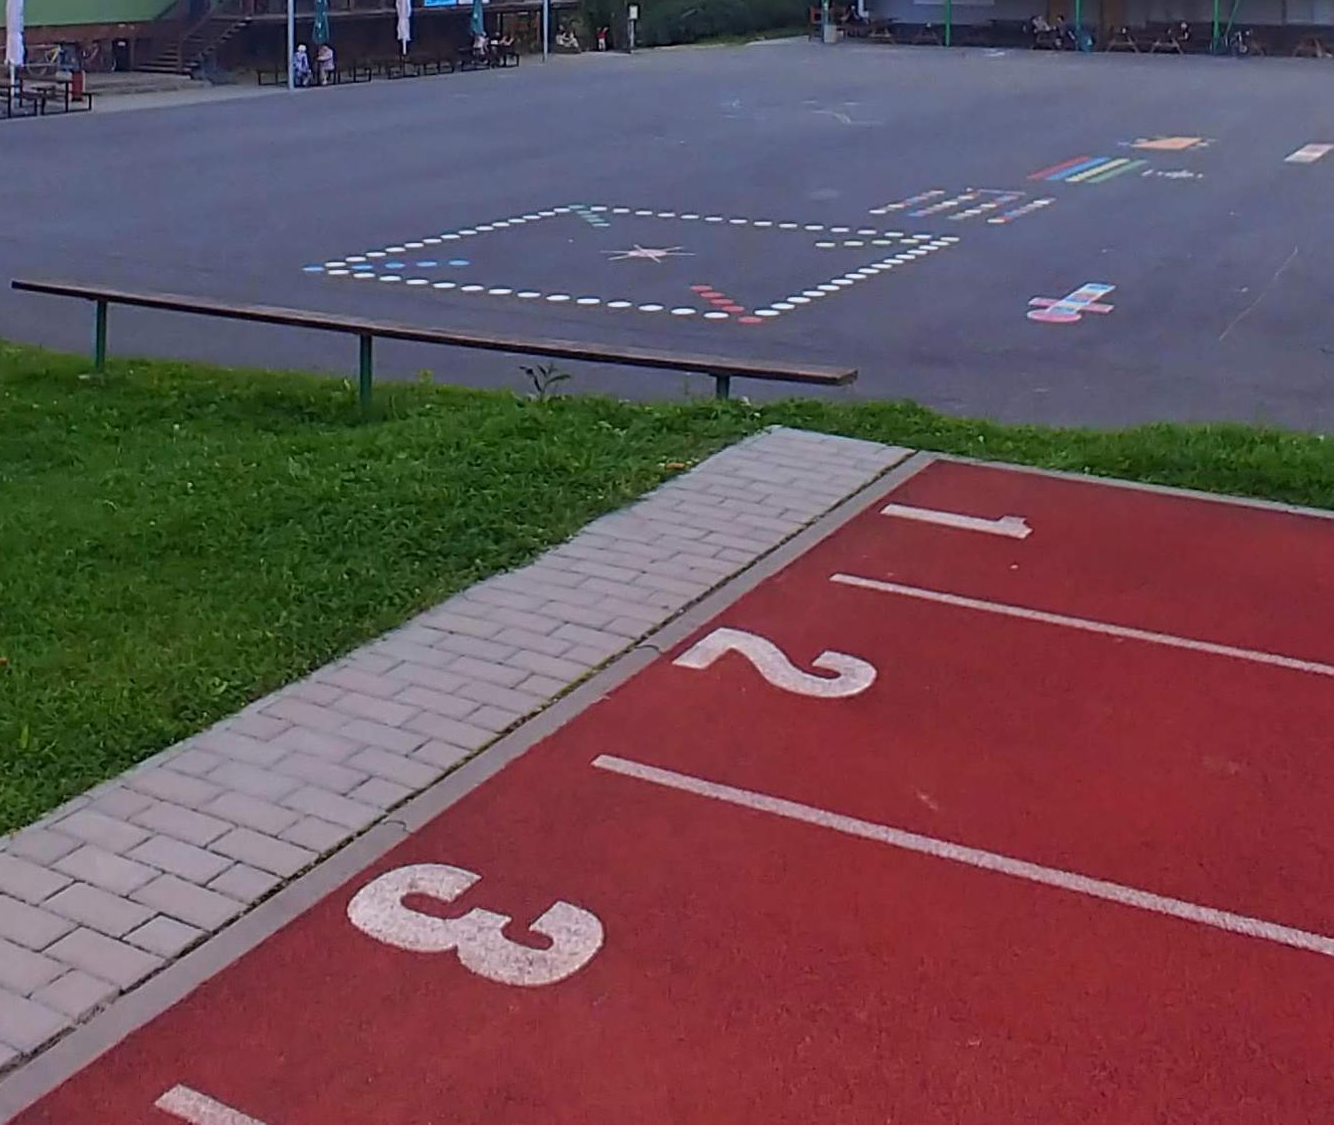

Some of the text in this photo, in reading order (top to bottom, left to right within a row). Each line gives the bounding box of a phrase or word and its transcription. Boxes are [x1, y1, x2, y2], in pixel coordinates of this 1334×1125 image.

[880, 504, 1032, 539] 1
[671, 627, 877, 698] 2
[346, 863, 605, 987] 3
